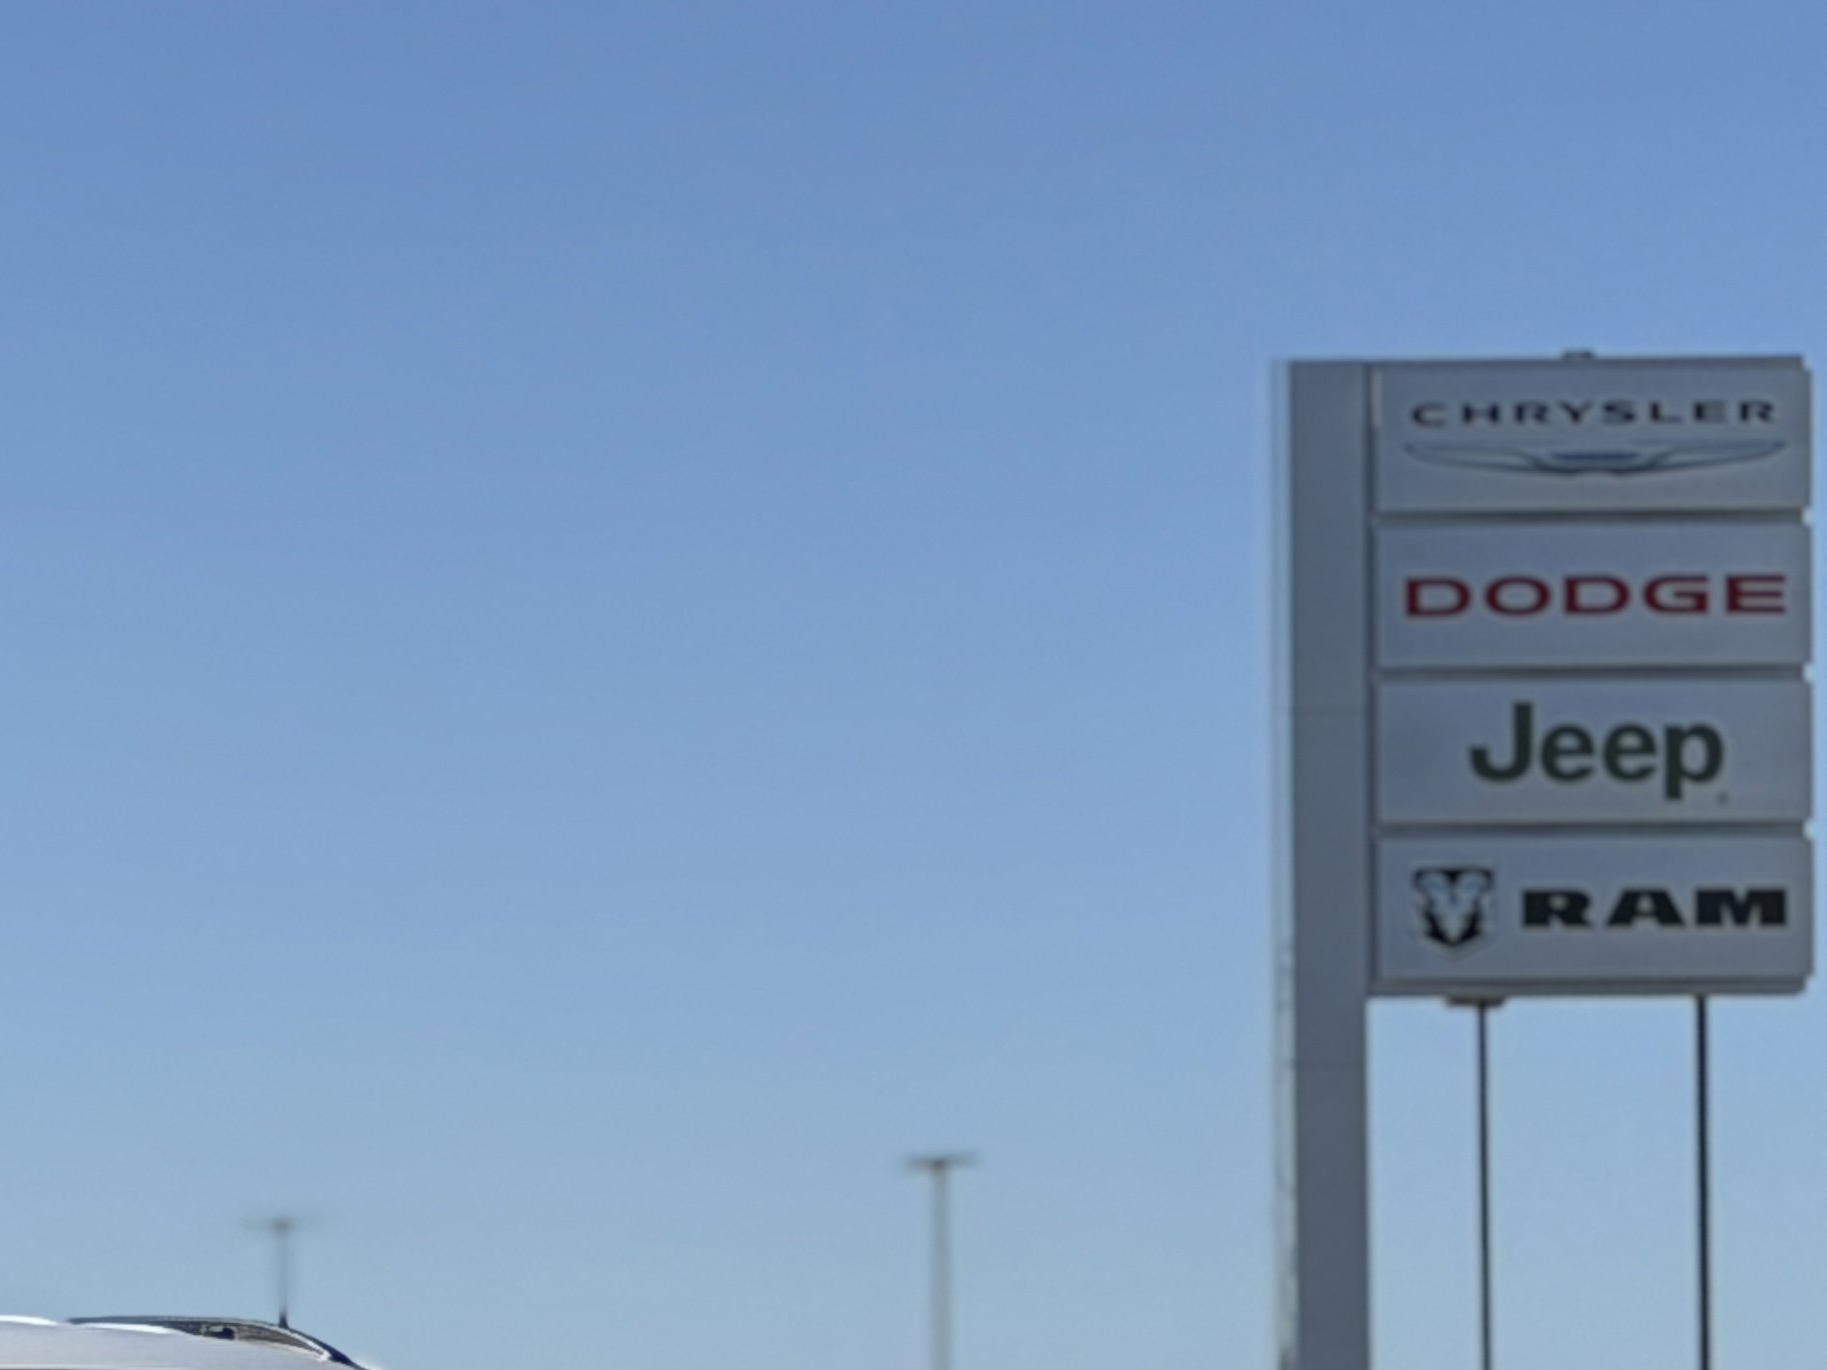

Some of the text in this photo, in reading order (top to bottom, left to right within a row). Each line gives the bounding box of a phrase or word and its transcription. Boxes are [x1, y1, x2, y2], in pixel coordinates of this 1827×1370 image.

[1411, 400, 1776, 427] CHRYSLER
[1403, 574, 1786, 617] DODGE
[1469, 703, 1724, 799] Jeep
[1522, 889, 1787, 927] RAM
